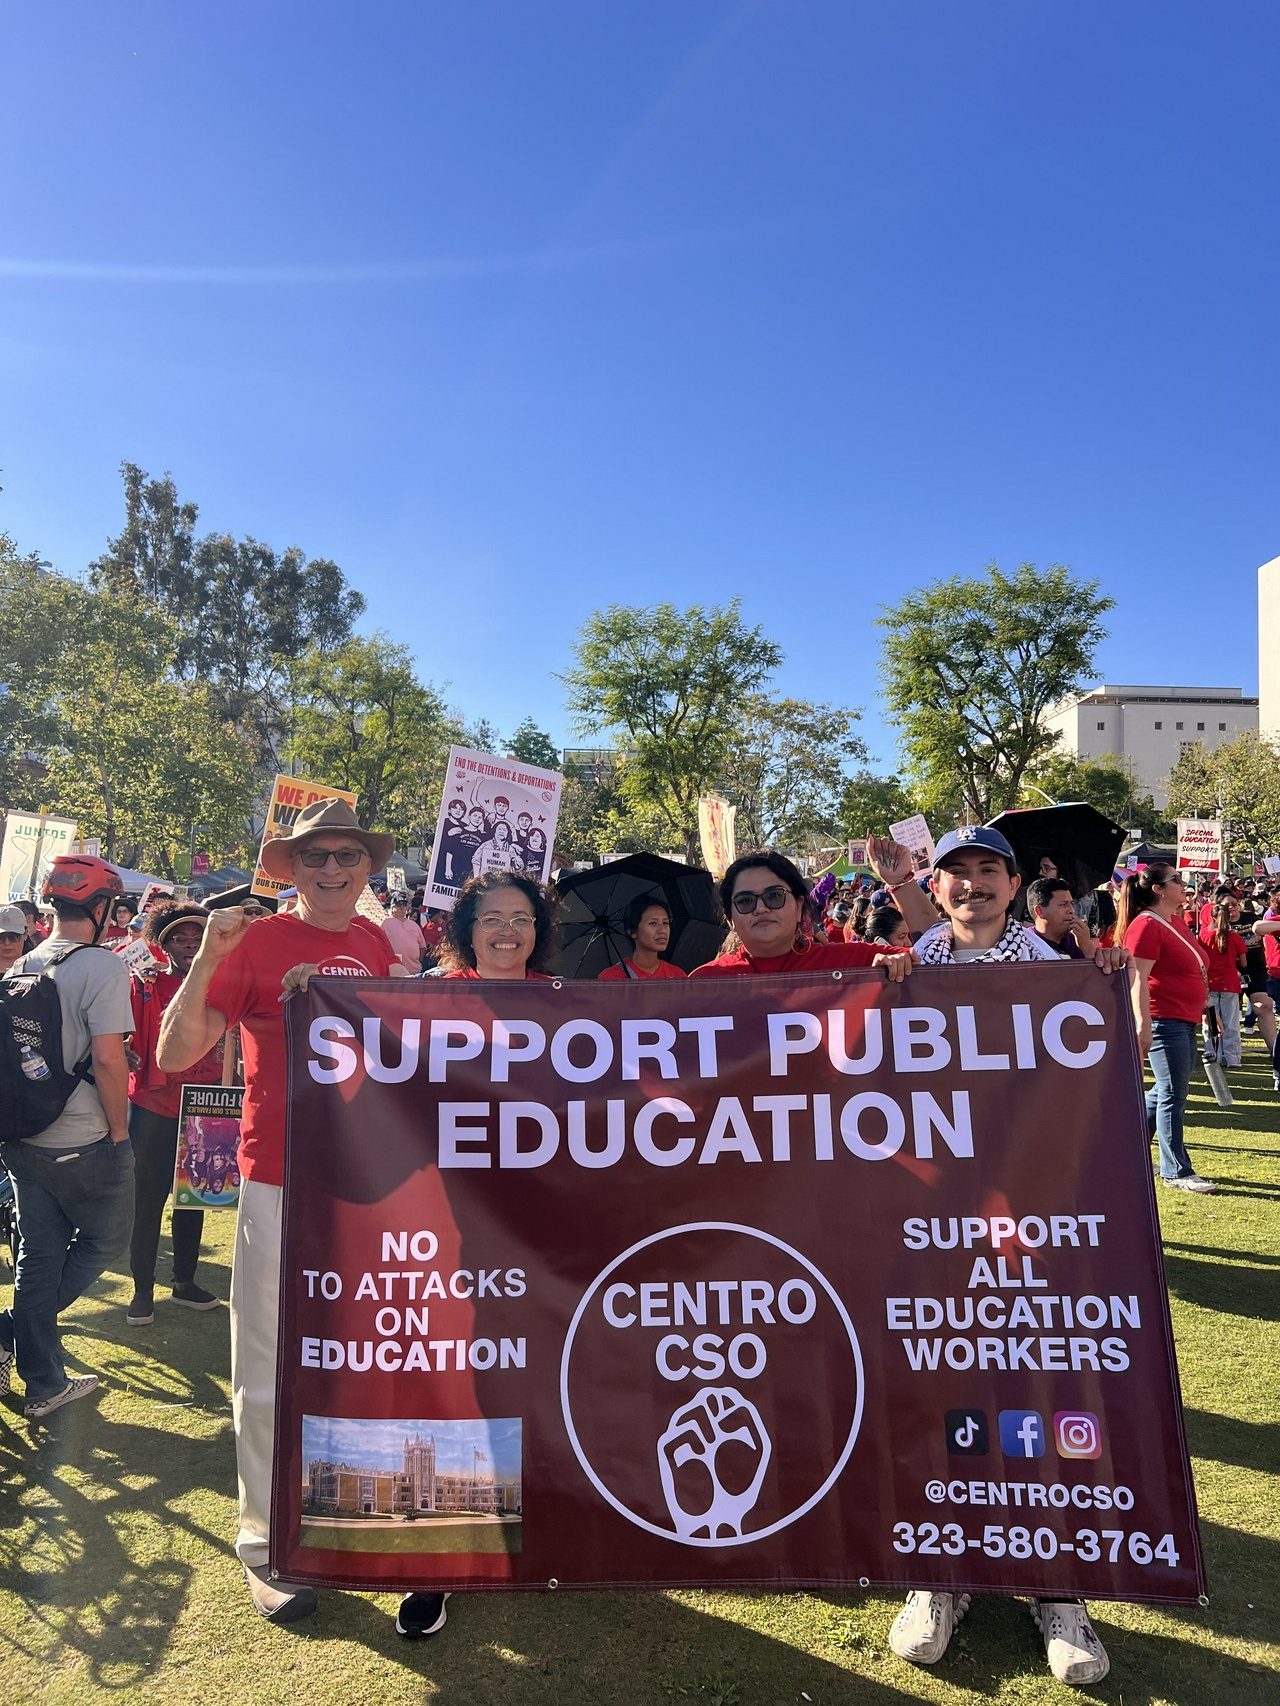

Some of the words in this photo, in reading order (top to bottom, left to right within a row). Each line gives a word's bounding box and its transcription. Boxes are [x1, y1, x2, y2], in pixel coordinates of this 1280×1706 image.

[455, 757, 466, 770] END
[467, 760, 477, 772] THE
[478, 763, 511, 781] DETENTIONS
[512, 771, 517, 782] &
[518, 774, 557, 792] DEPORTATIONS
[277, 784, 305, 807] WE
[15, 825, 67, 840] JUNTOS
[1180, 836, 1220, 844] EDUCATION
[1188, 860, 1211, 868] NOW!
[256, 878, 270, 888] OUR
[321, 966, 367, 977] CENTRO
[308, 1015, 734, 1086] SUPPORT
[767, 1000, 1107, 1076] PUBLIC
[187, 1091, 236, 1107] FUTURE.
[437, 1090, 975, 1169] EDUCATION
[381, 1230, 439, 1262] NO
[903, 1215, 1106, 1250] SUPPORT
[302, 1269, 343, 1301] TO
[354, 1268, 527, 1301] ATTACKS
[967, 1255, 1048, 1289] ALL
[602, 1278, 817, 1329] CENTRO
[886, 1295, 1141, 1330] EDUCATION
[375, 1306, 429, 1337] ON
[301, 1336, 527, 1372] EDUCATION
[655, 1332, 767, 1381] CSO
[902, 1336, 1130, 1372] WORKERS
[924, 1479, 1135, 1512] @CENTROCSO
[892, 1521, 1180, 1568] 323-580-3764
